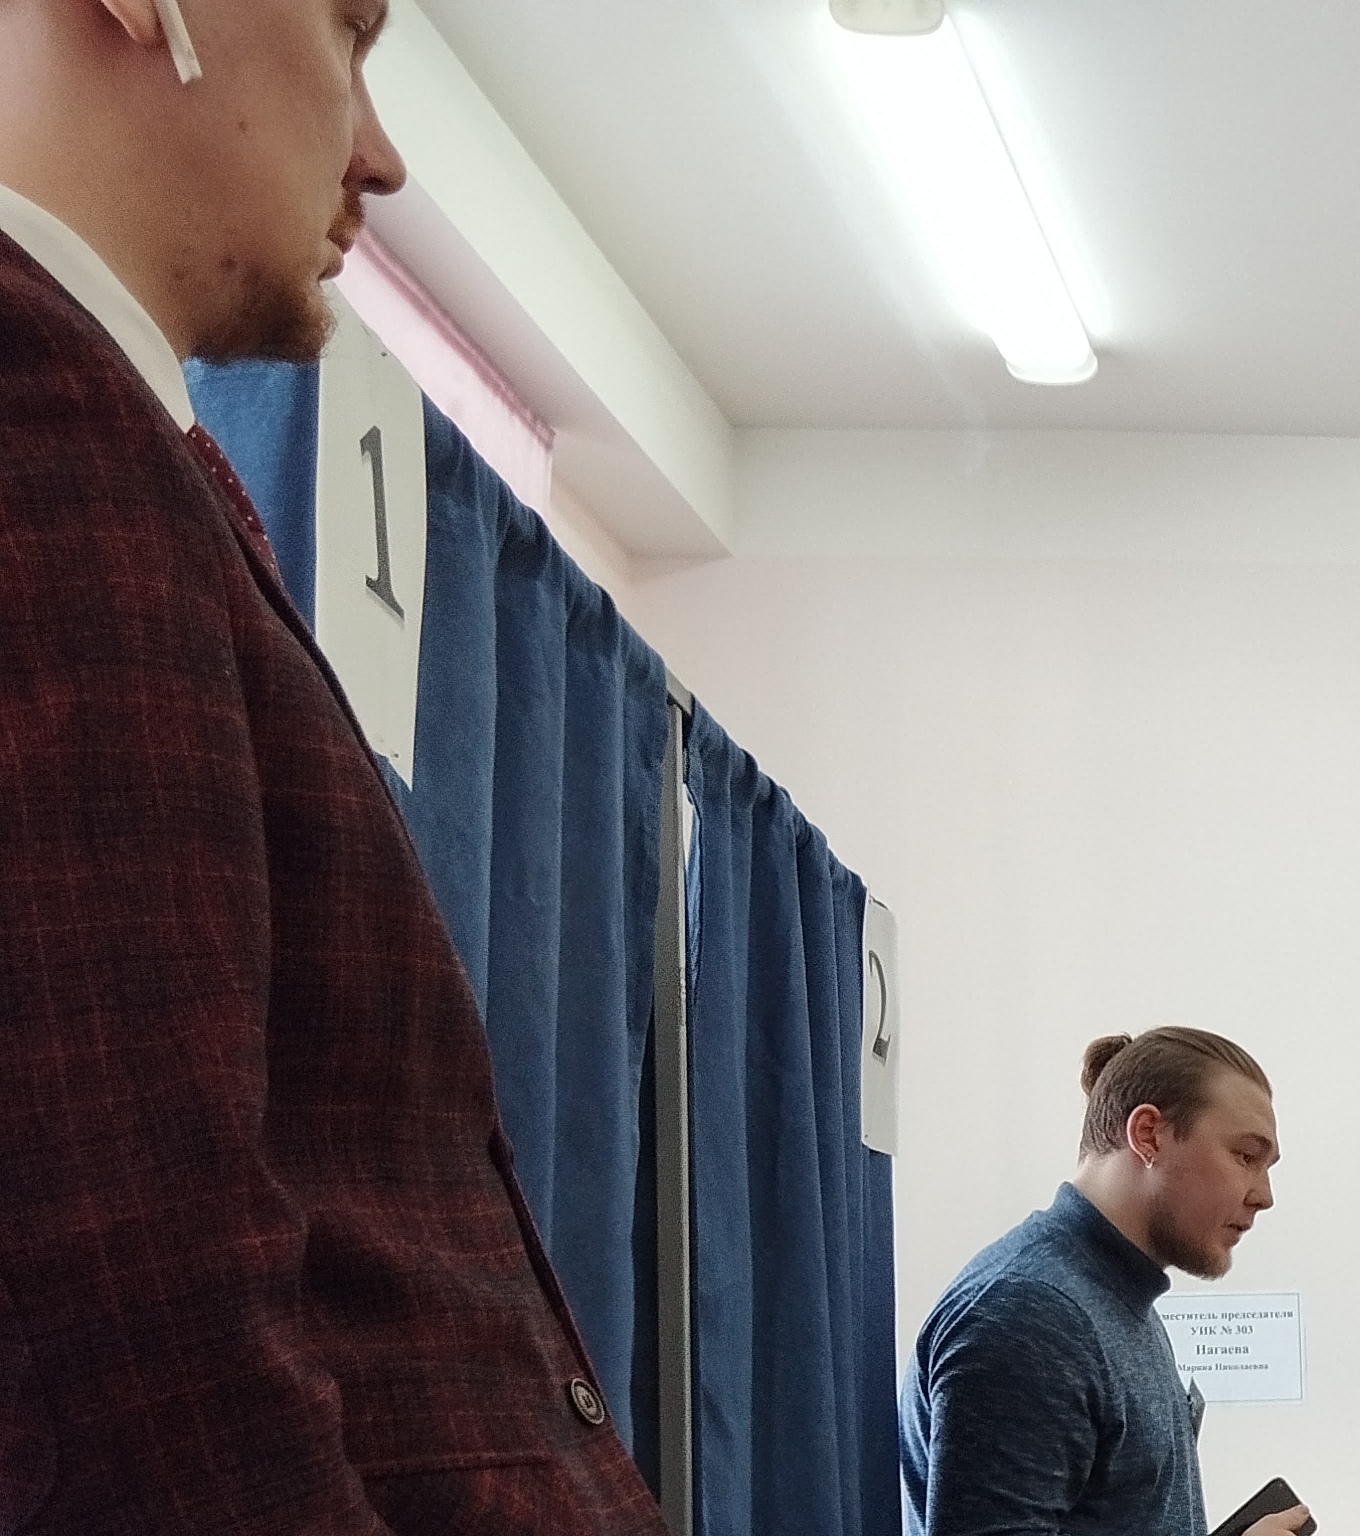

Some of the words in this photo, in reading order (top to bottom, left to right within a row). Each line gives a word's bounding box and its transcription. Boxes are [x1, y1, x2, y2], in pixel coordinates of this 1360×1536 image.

[360, 425, 405, 621] 1
[868, 950, 891, 1060] 2
[1161, 1311, 1218, 1321] меститель
[1221, 1310, 1294, 1322] председателя
[1190, 1325, 1217, 1335] УИК
[1220, 1325, 1232, 1335] №
[1235, 1325, 1254, 1335] 303
[1196, 1345, 1250, 1356] Нагаева
[1215, 1362, 1269, 1372] Николаевна
